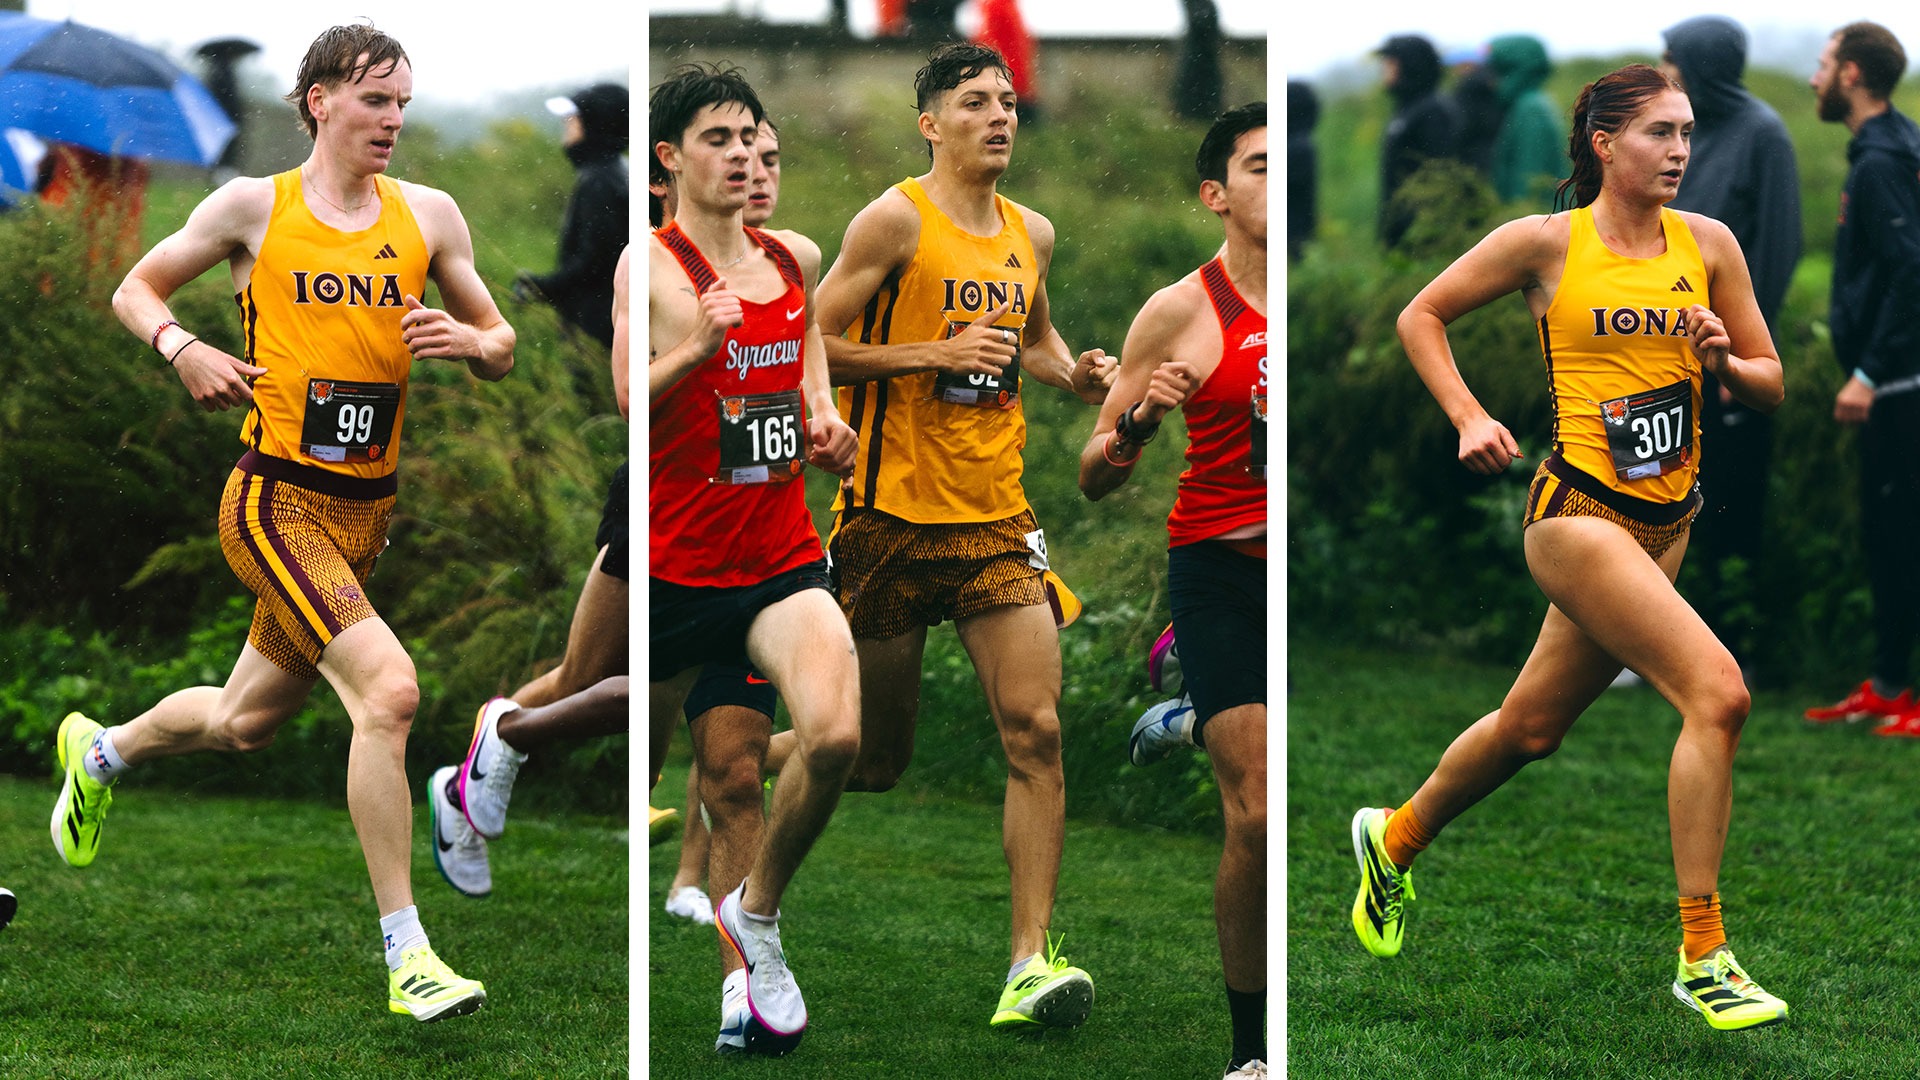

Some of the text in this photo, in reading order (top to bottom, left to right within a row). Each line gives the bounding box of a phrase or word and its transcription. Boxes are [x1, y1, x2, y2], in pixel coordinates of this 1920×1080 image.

[291, 271, 404, 306] IONA
[941, 279, 1027, 315] IONA
[1241, 332, 1267, 346] AC
[1590, 307, 1688, 336] IONA
[336, 403, 375, 444] 99
[746, 414, 797, 462] 165
[1631, 405, 1684, 459] 307
